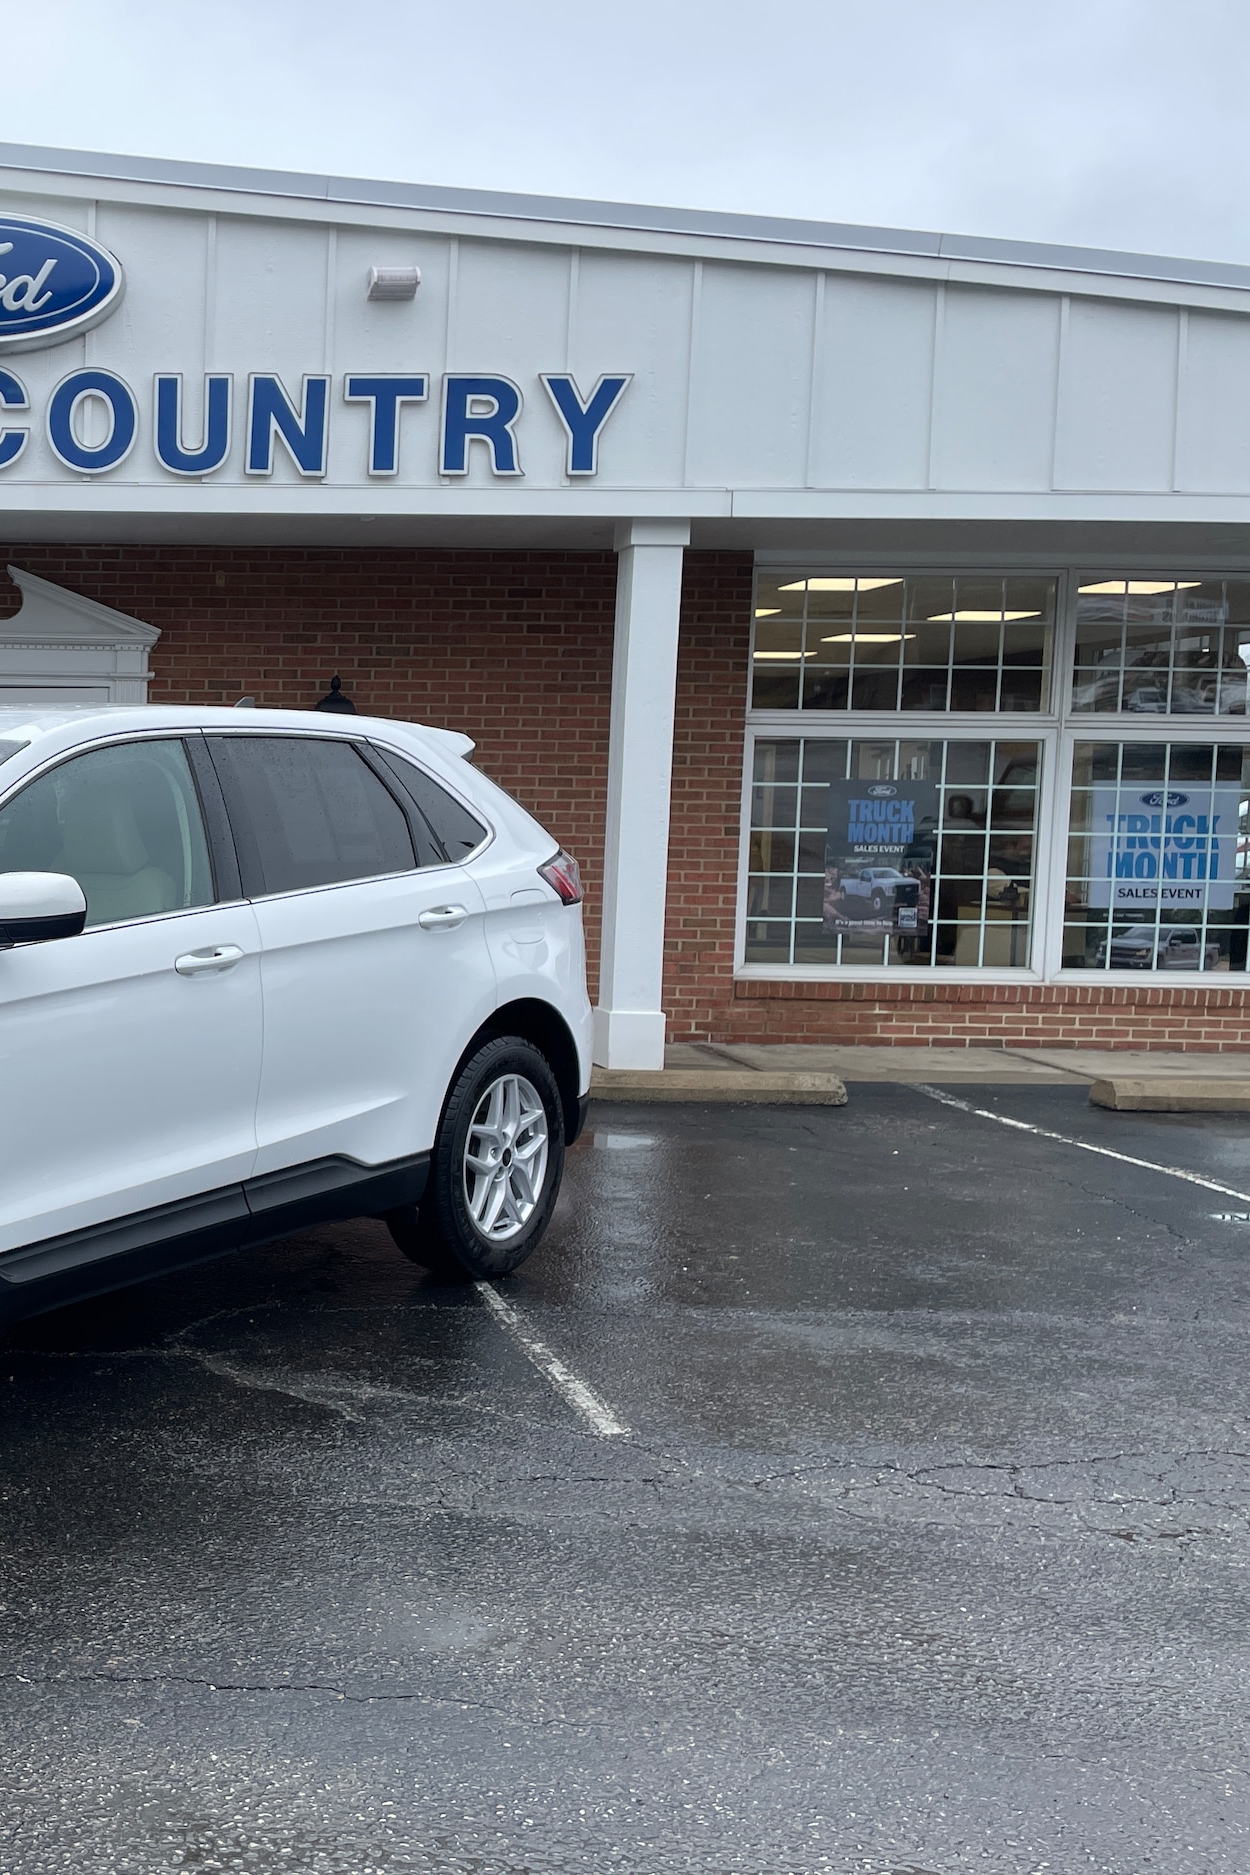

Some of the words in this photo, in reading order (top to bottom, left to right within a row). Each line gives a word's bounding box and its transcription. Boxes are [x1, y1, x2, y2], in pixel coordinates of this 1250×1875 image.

[848, 799, 915, 822] TRUCK
[848, 823, 914, 843] MONTH
[1106, 814, 1221, 850] TRUCK
[853, 845, 879, 853] SALES
[879, 845, 905, 853] EVENT
[1106, 851, 1219, 883] MONTH
[1117, 888, 1158, 899] SALES
[1161, 888, 1203, 899] EVENT
